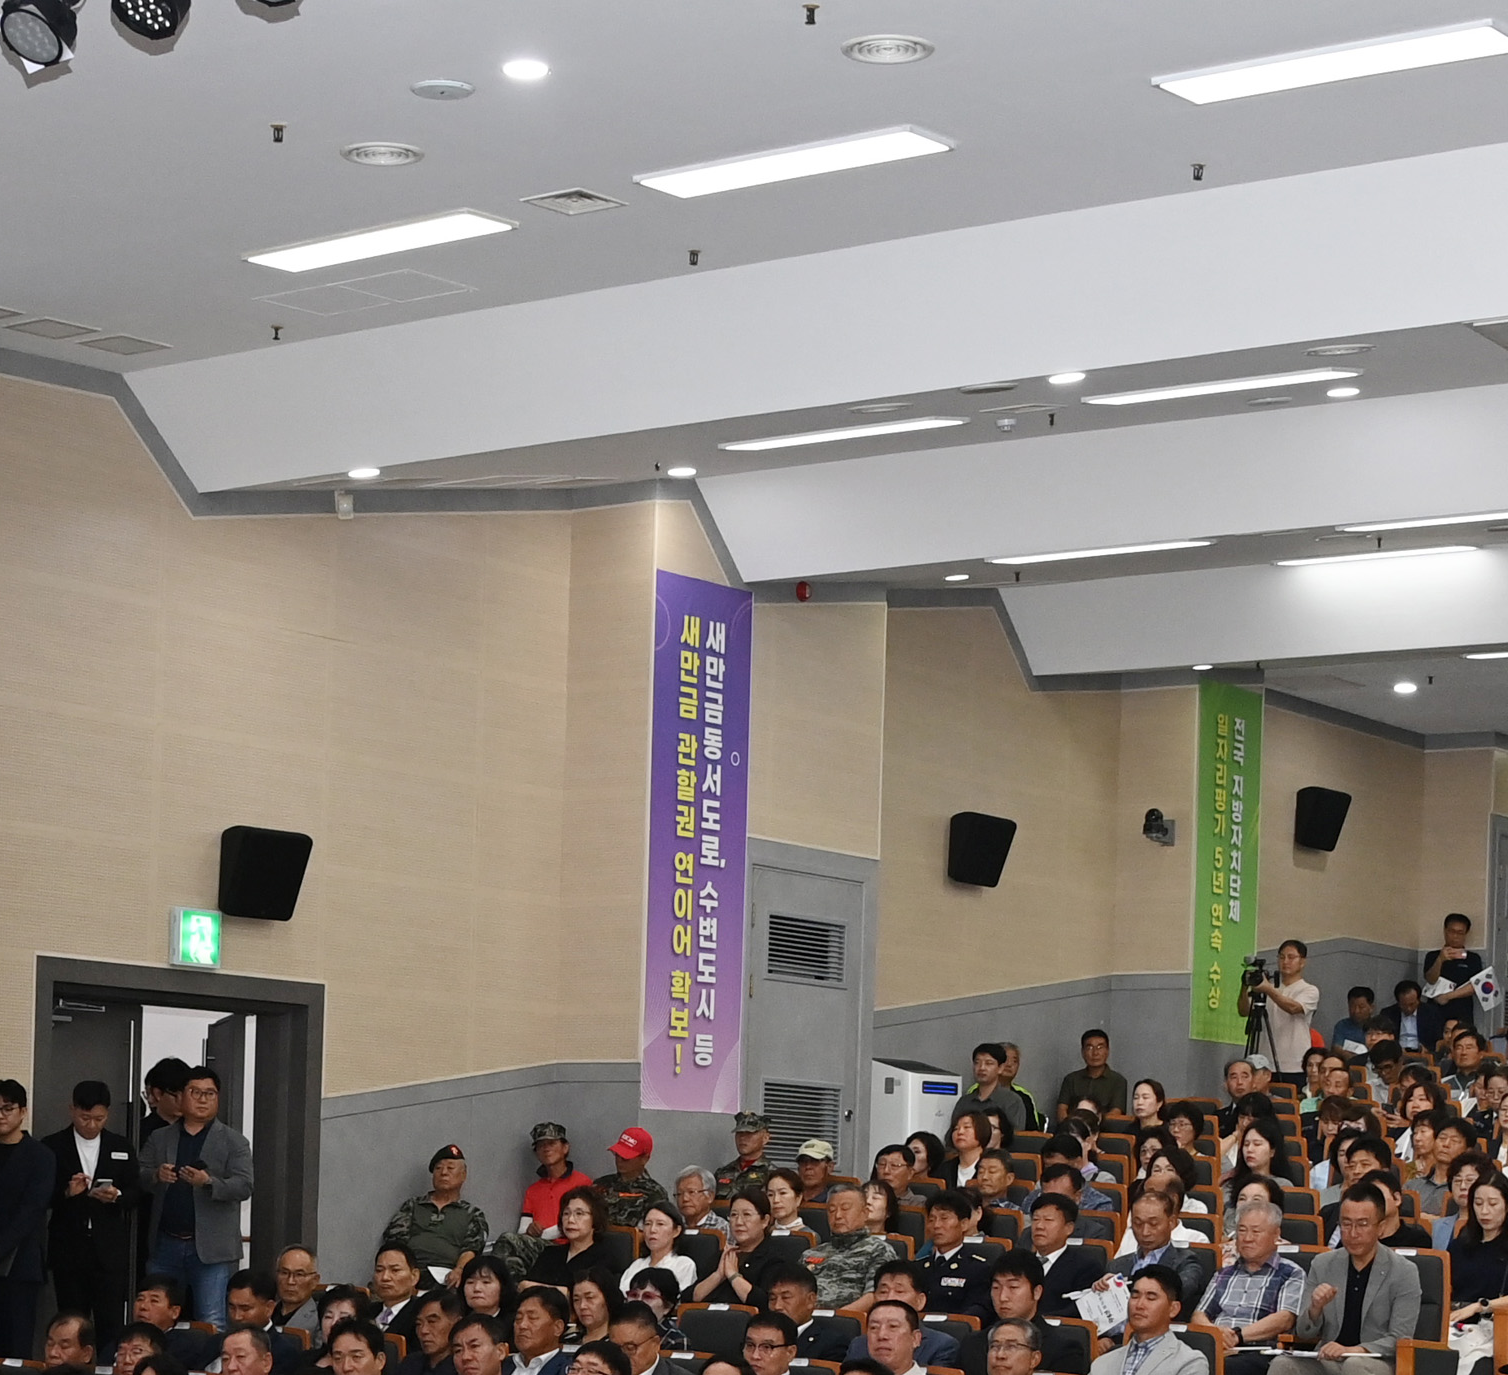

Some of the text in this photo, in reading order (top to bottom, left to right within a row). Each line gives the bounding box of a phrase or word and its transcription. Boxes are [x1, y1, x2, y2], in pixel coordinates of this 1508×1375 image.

[668, 614, 701, 1074] 새만금 관할권 연이어 확보!
[1228, 717, 1246, 923] 전국 지방자치단체
[1212, 847, 1224, 894] 5년
[695, 881, 719, 1021] 수변도시
[1210, 903, 1223, 952] 연속
[1208, 961, 1221, 1009] 수상
[694, 1033, 714, 1067] 등
